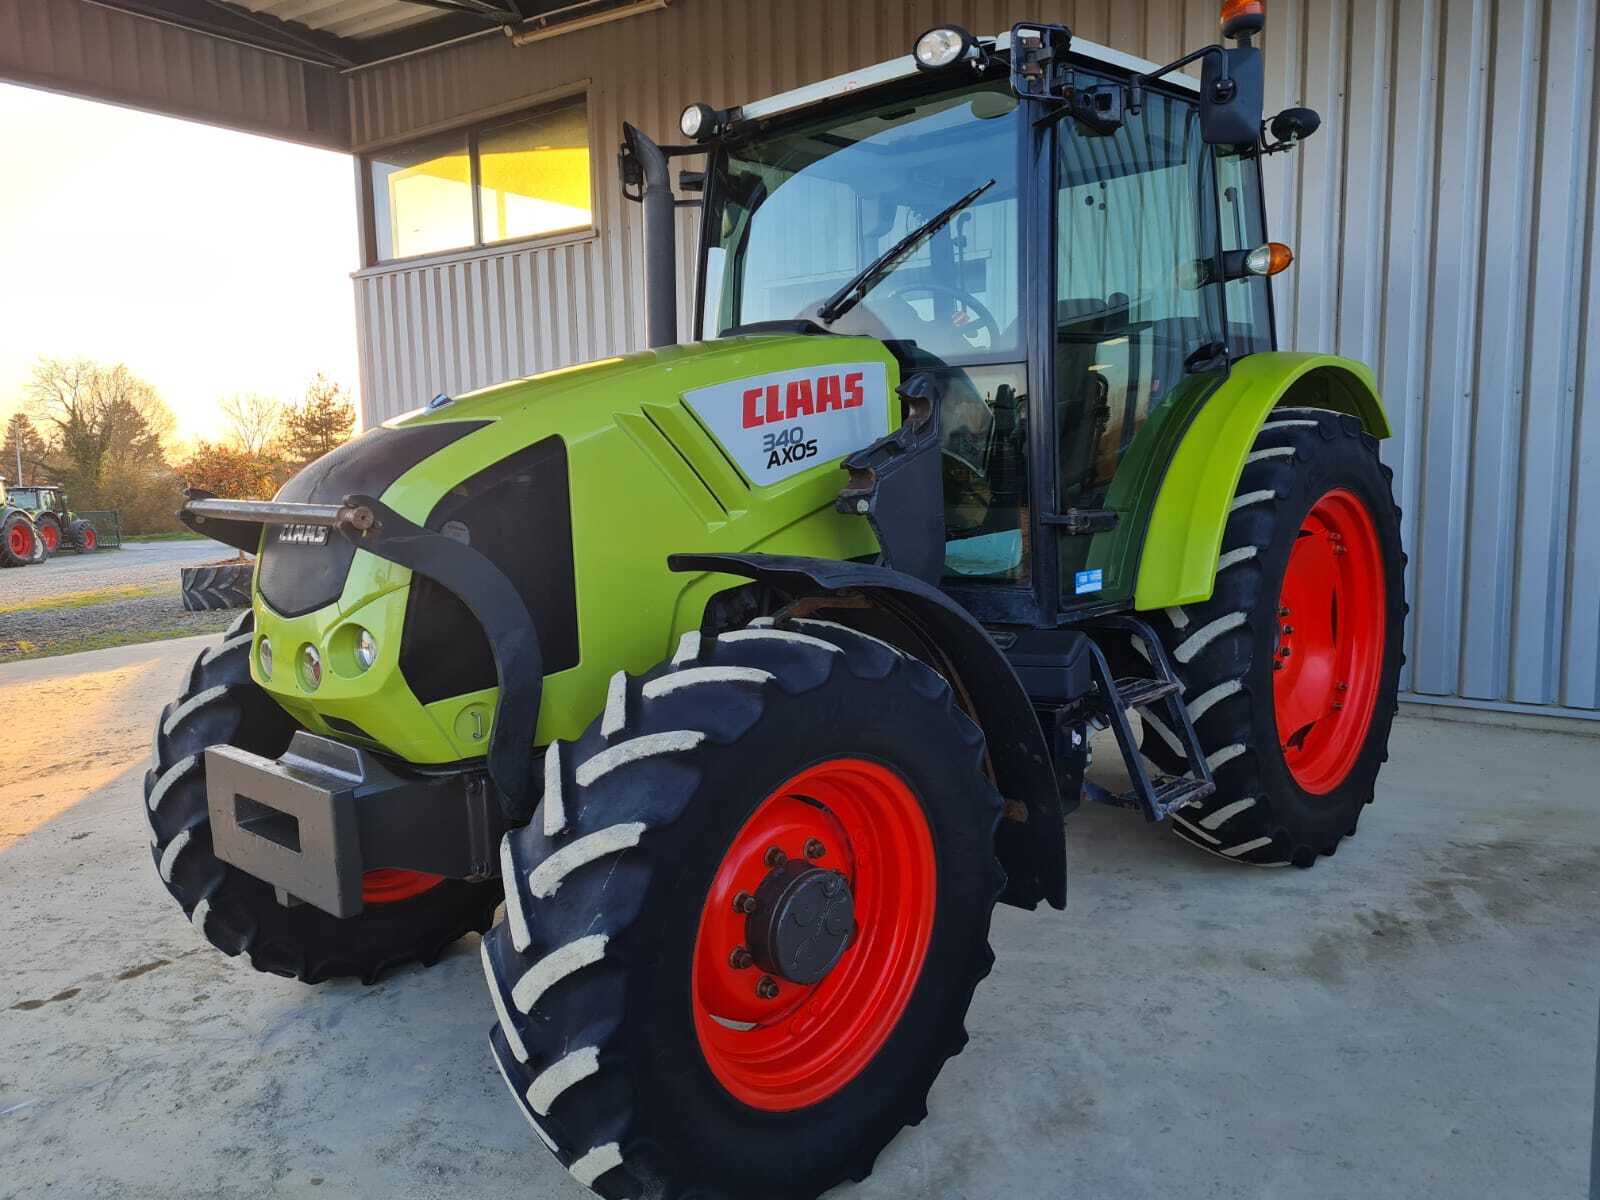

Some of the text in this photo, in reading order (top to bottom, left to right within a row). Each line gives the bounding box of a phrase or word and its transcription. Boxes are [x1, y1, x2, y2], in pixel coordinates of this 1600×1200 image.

[742, 373, 863, 429] CLAAS
[763, 427, 804, 452] 340
[767, 439, 818, 469] AXOS
